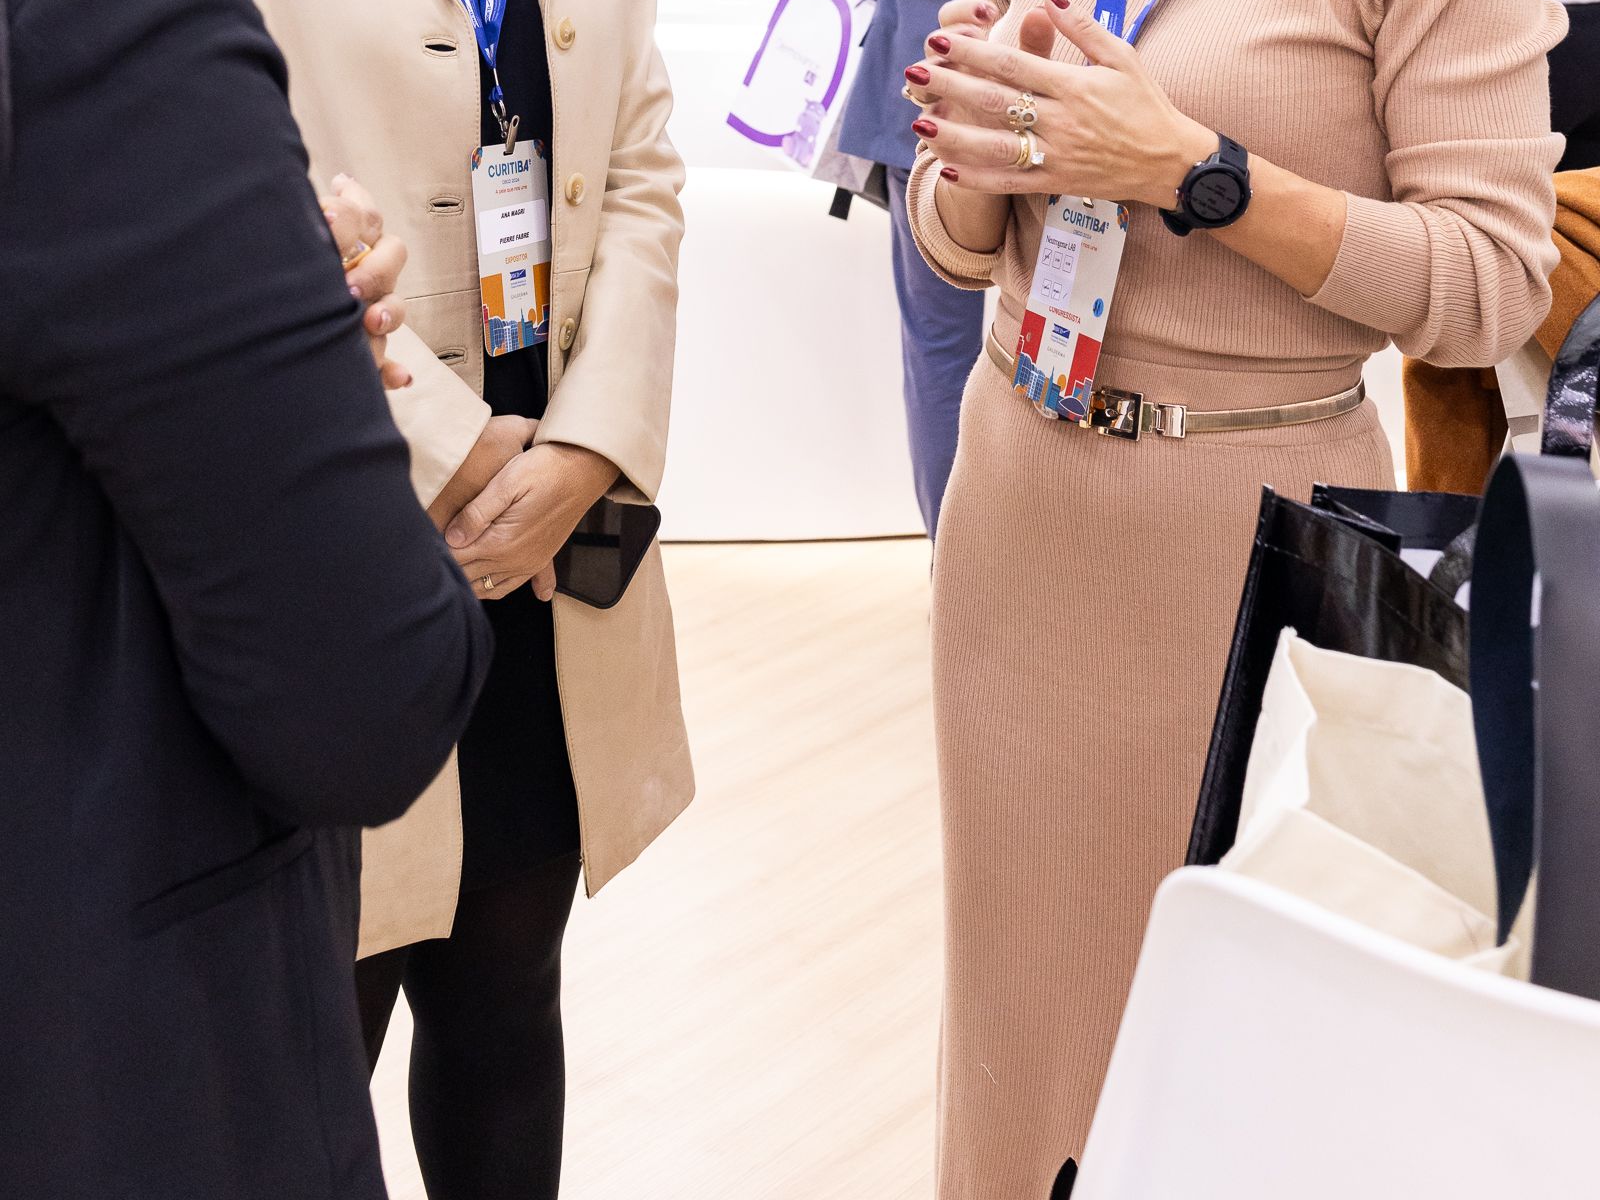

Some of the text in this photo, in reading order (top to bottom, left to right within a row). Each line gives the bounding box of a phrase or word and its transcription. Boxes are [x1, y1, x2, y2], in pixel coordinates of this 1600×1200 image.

[501, 211, 510, 219] ANA
[499, 231, 530, 245] PIERRE FABRE
[505, 253, 528, 264] EXPOSITOR
[1048, 306, 1081, 325] CONGRESSISTA
